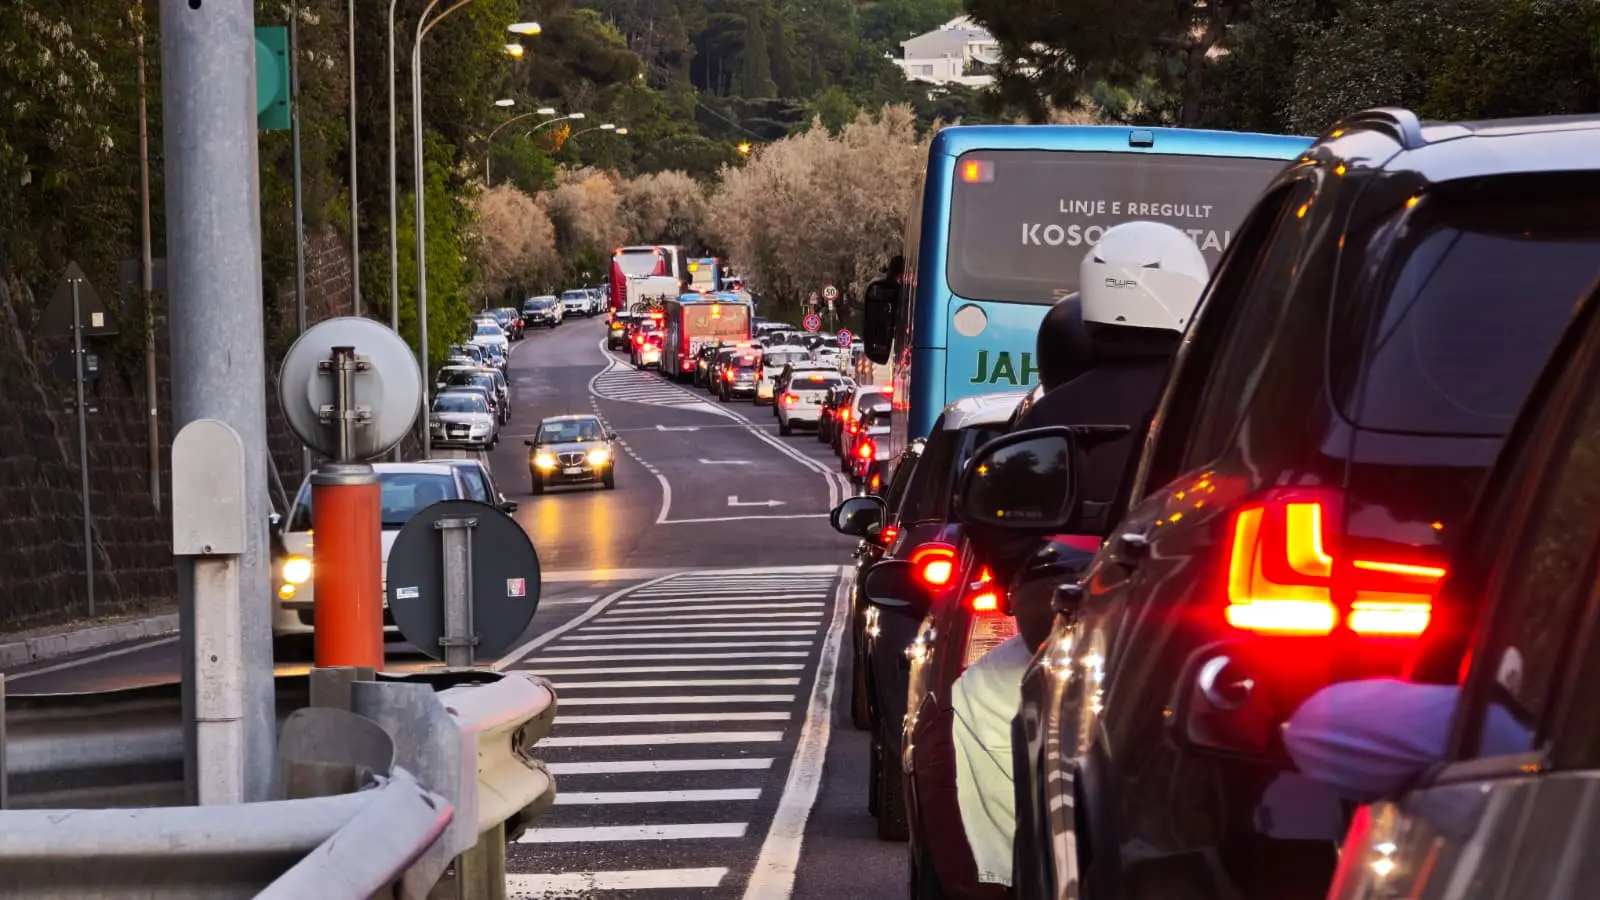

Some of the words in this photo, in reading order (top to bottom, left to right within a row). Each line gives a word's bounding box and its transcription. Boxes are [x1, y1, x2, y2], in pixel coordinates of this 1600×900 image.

[1059, 199, 1106, 217] LINJE
[1112, 202, 1121, 215] E
[1127, 202, 1213, 219] RREGULLT
[1021, 222, 1112, 247] KOSO
[825, 287, 836, 297] 50
